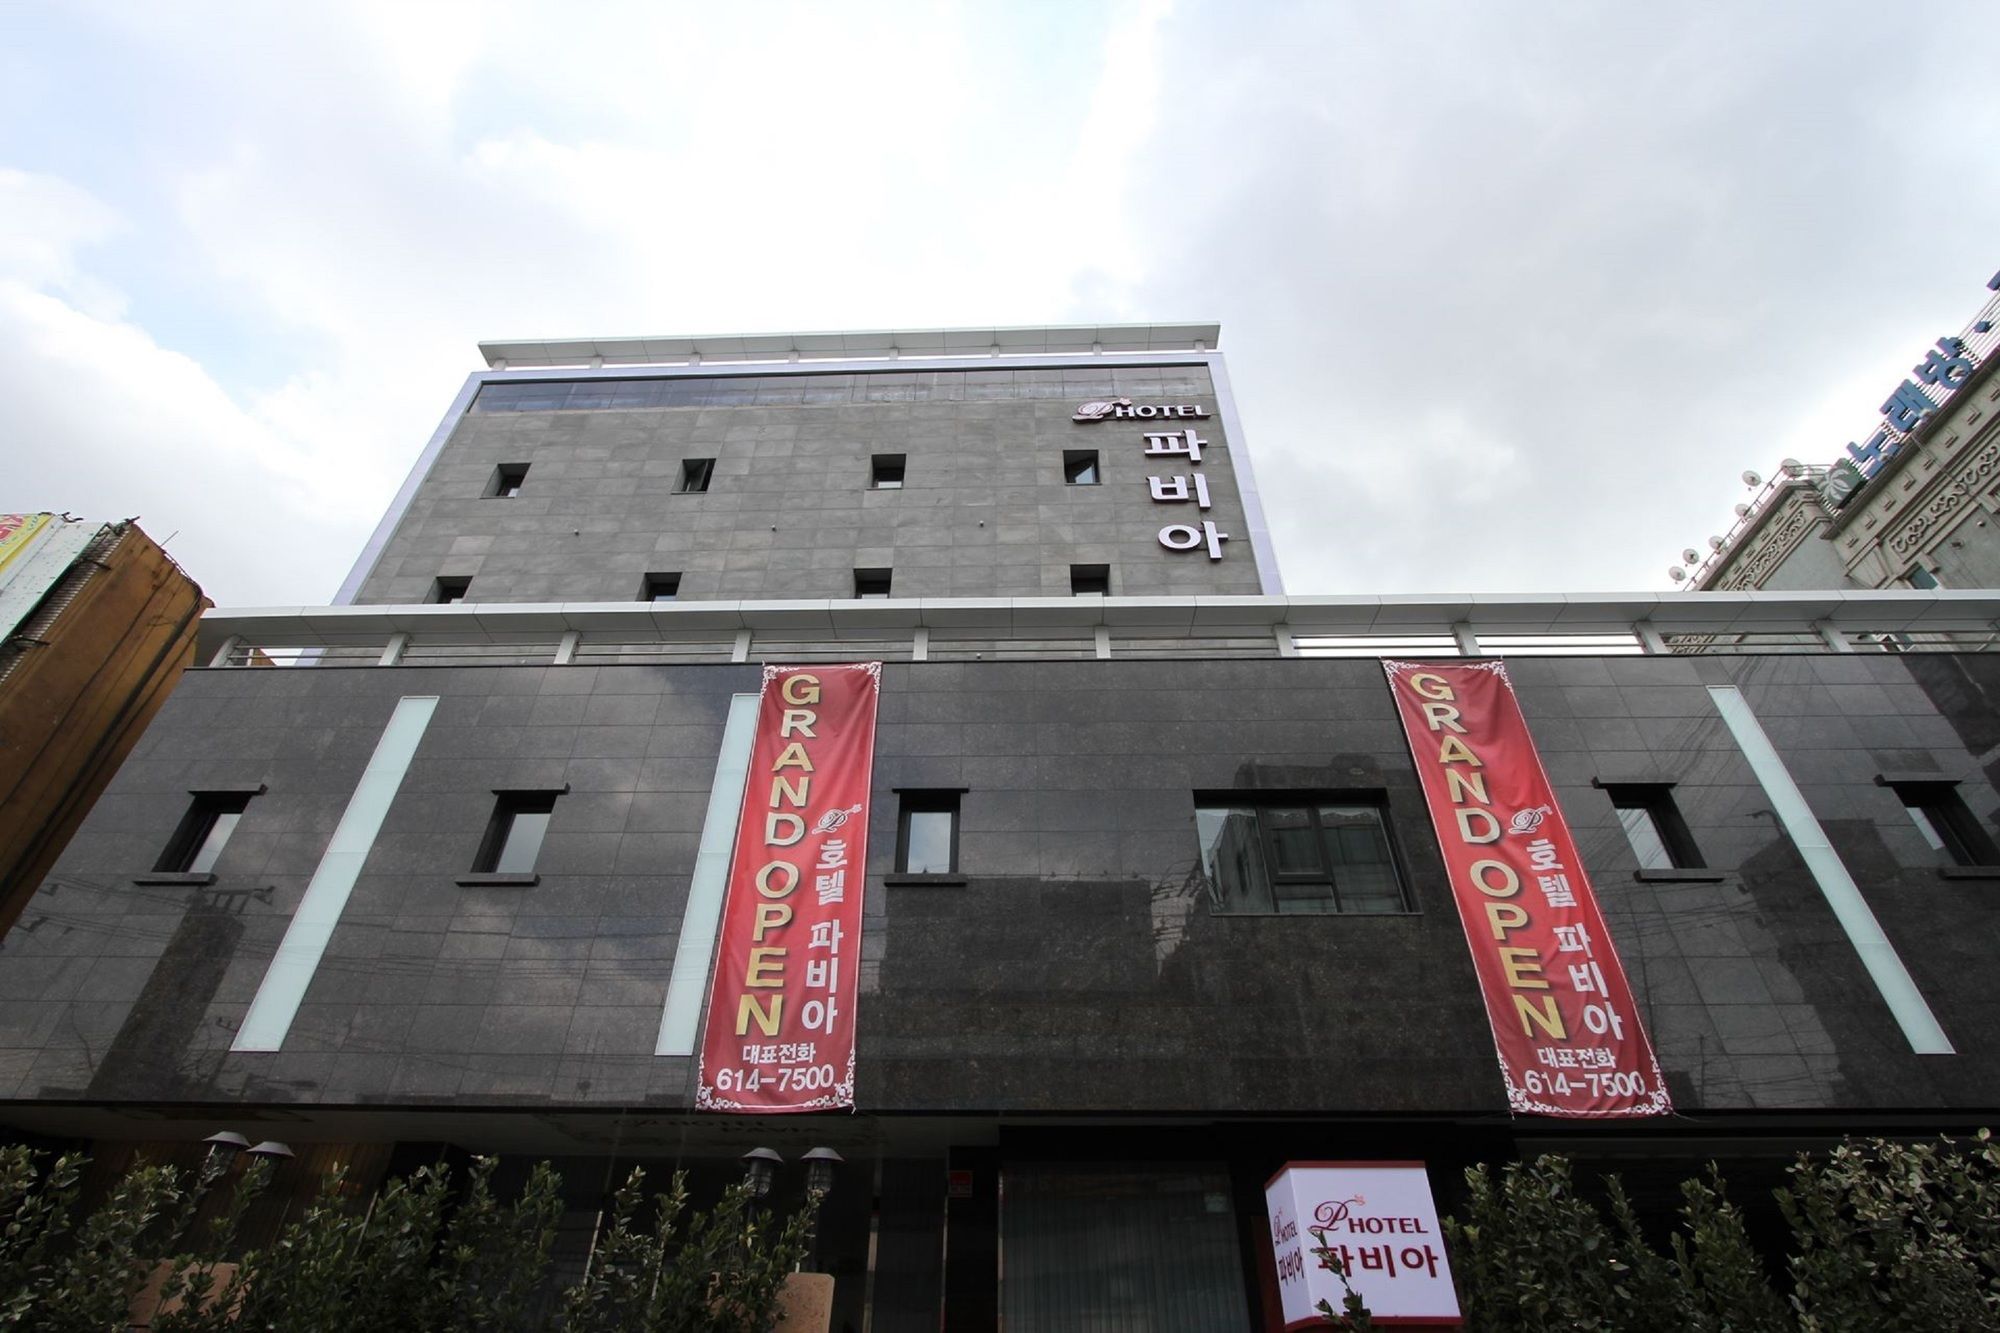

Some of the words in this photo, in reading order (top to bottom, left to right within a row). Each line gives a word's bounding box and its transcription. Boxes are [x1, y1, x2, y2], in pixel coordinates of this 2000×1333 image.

[1115, 405, 1212, 419] HOTEL
[1143, 429, 1229, 561] 파비아
[765, 673, 821, 847] GRAND
[816, 839, 848, 906] 호텔
[1410, 673, 1501, 844] GRAND
[1470, 859, 1567, 1040] OPEN
[735, 860, 800, 1037] OPEN
[1526, 838, 1577, 907] 호텔
[1552, 922, 1624, 1041] 파비아
[801, 919, 844, 1035] 파비아
[742, 1043, 816, 1065] 대표전화
[1537, 1047, 1617, 1069] 대표전화
[716, 1064, 834, 1092] 614-7500
[1525, 1070, 1646, 1097] 614-7500
[1280, 1220, 1298, 1244] HOTEL
[1348, 1217, 1429, 1234] HOTEL
[1278, 1246, 1305, 1287] 파비아
[1318, 1244, 1439, 1278] 파비아
